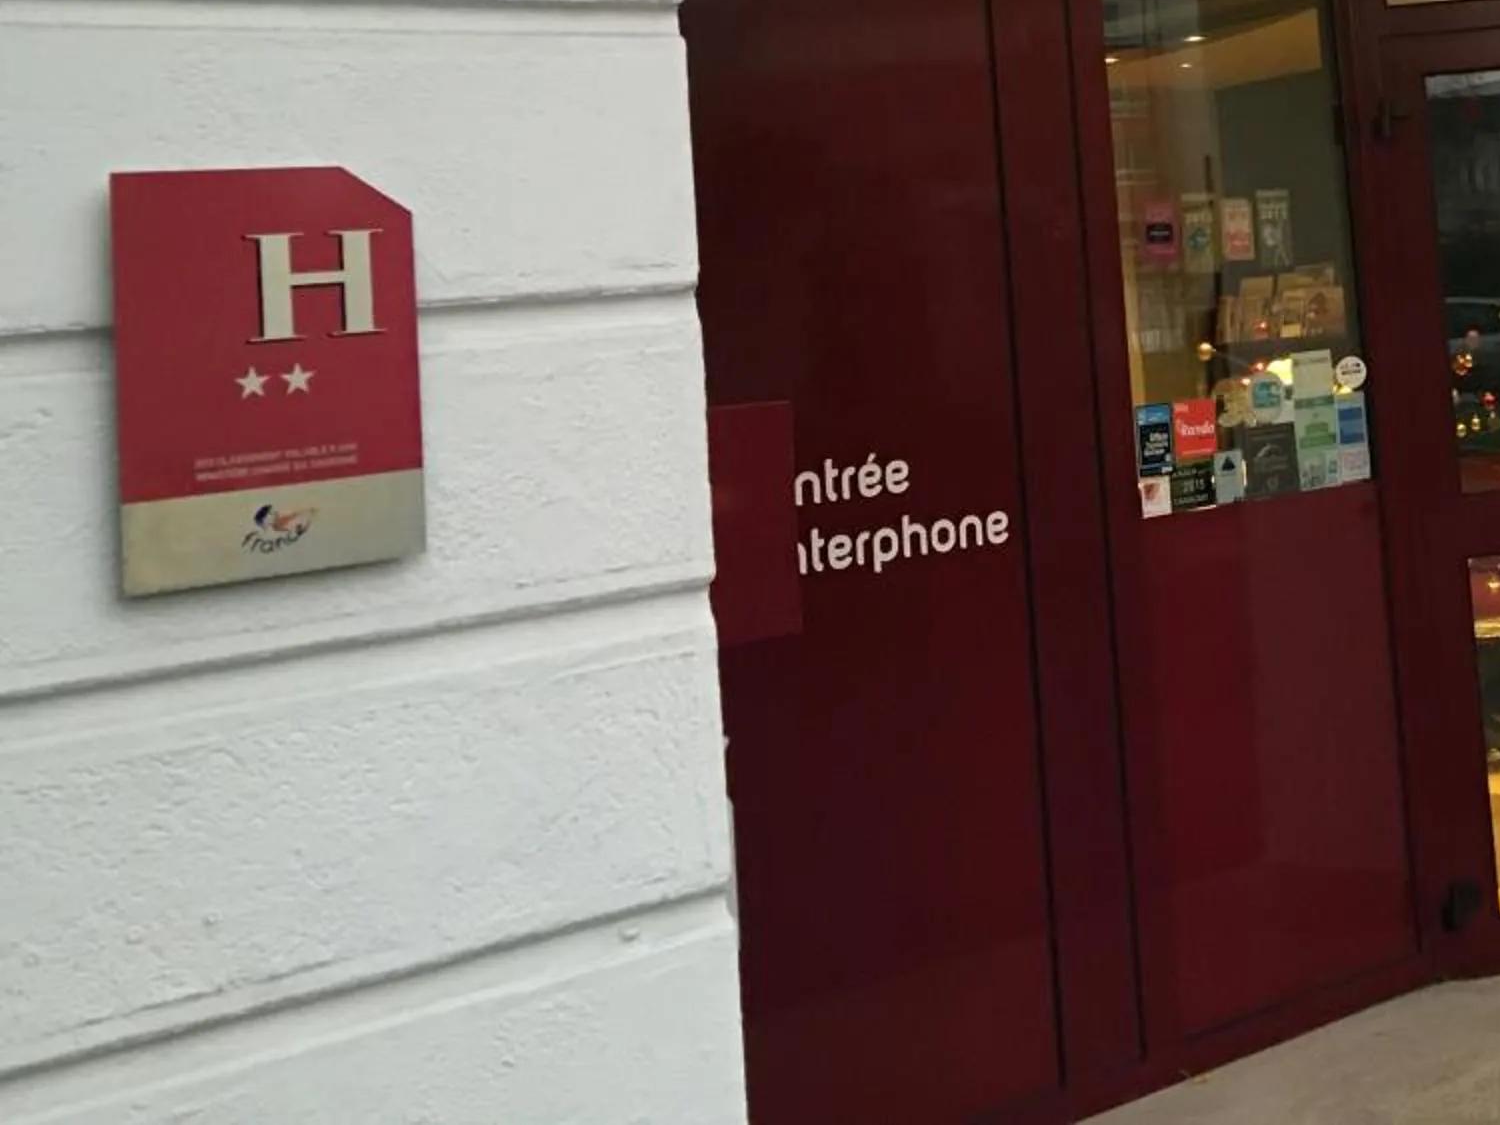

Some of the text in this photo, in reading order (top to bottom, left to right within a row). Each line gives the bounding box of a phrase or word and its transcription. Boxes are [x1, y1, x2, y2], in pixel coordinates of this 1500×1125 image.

[241, 228, 388, 344] H
[794, 452, 910, 506] ntrée
[797, 510, 1009, 575] nterphone
